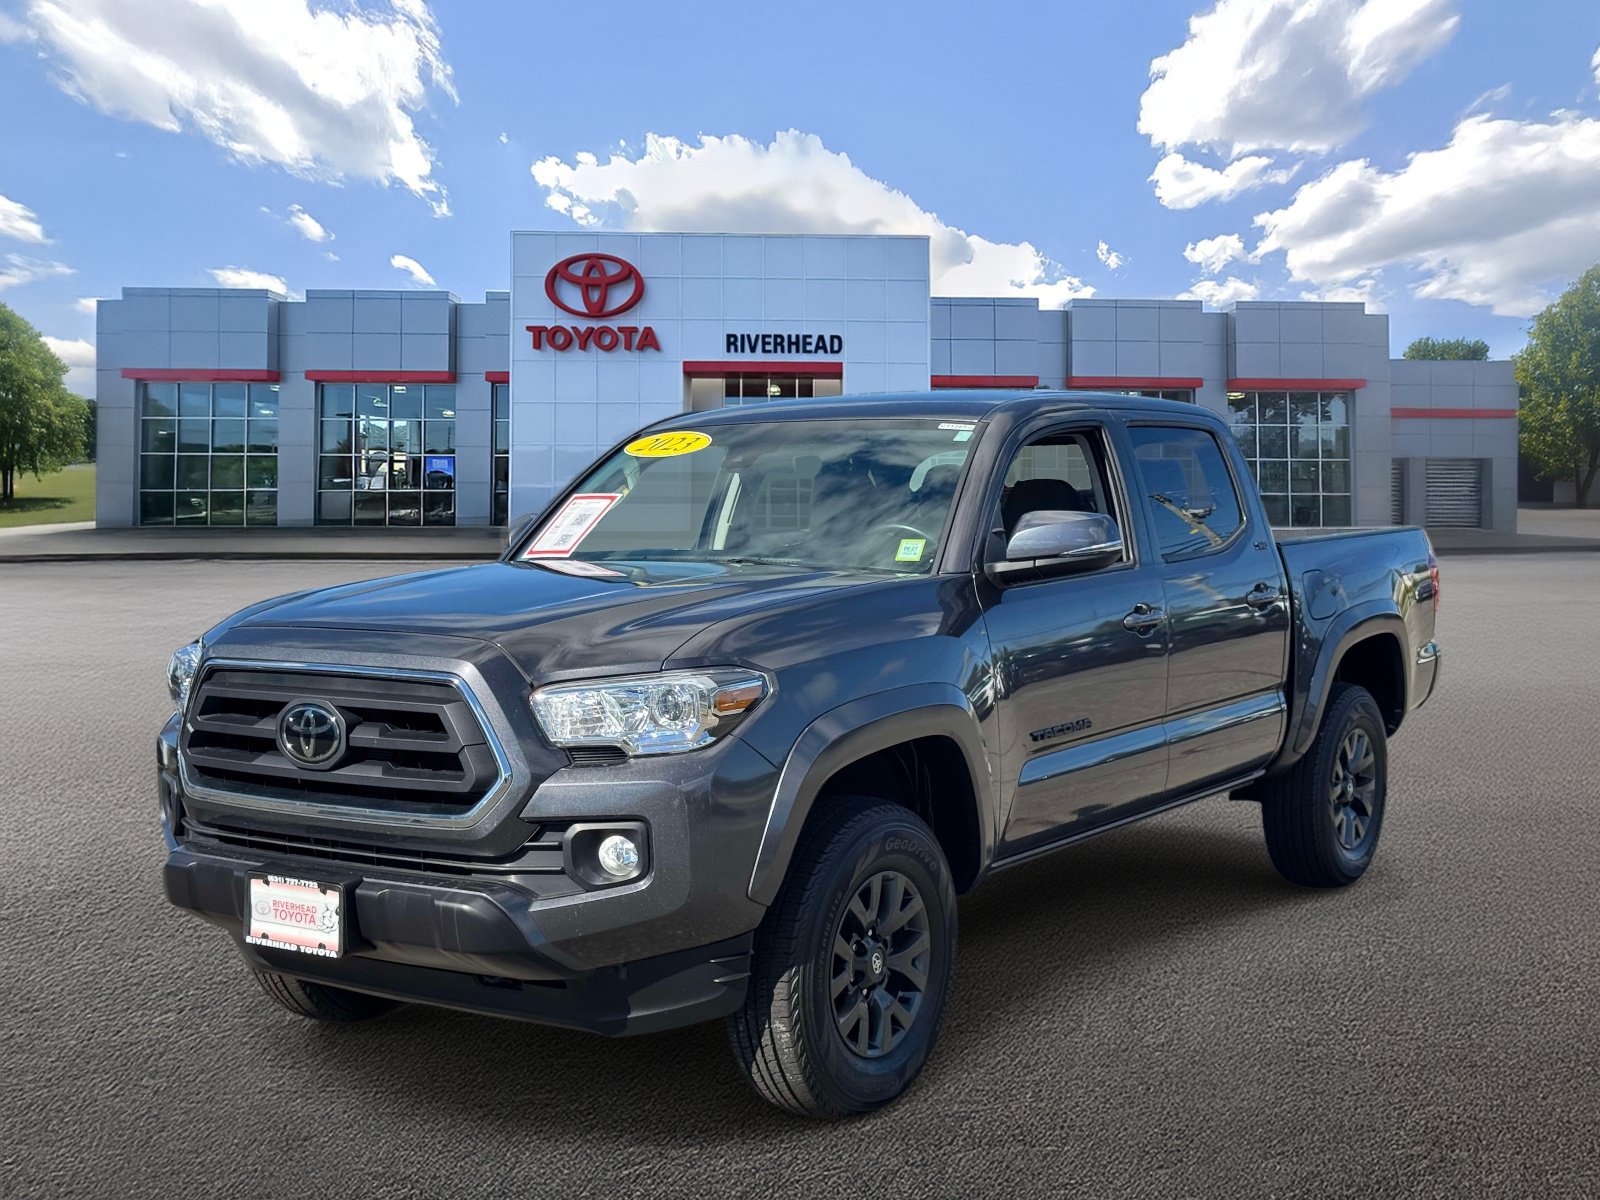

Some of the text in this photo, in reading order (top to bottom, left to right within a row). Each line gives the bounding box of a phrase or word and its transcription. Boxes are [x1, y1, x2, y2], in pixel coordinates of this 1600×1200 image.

[526, 325, 661, 352] TOYOTA
[725, 333, 843, 354] RIVERHEAD
[633, 437, 701, 451] 2023
[1029, 718, 1092, 741] TACOMA
[272, 900, 317, 913] RIVERHEAD
[273, 908, 316, 925] TOYOTA
[245, 935, 338, 958] RIVERHEAD TOYOTA
